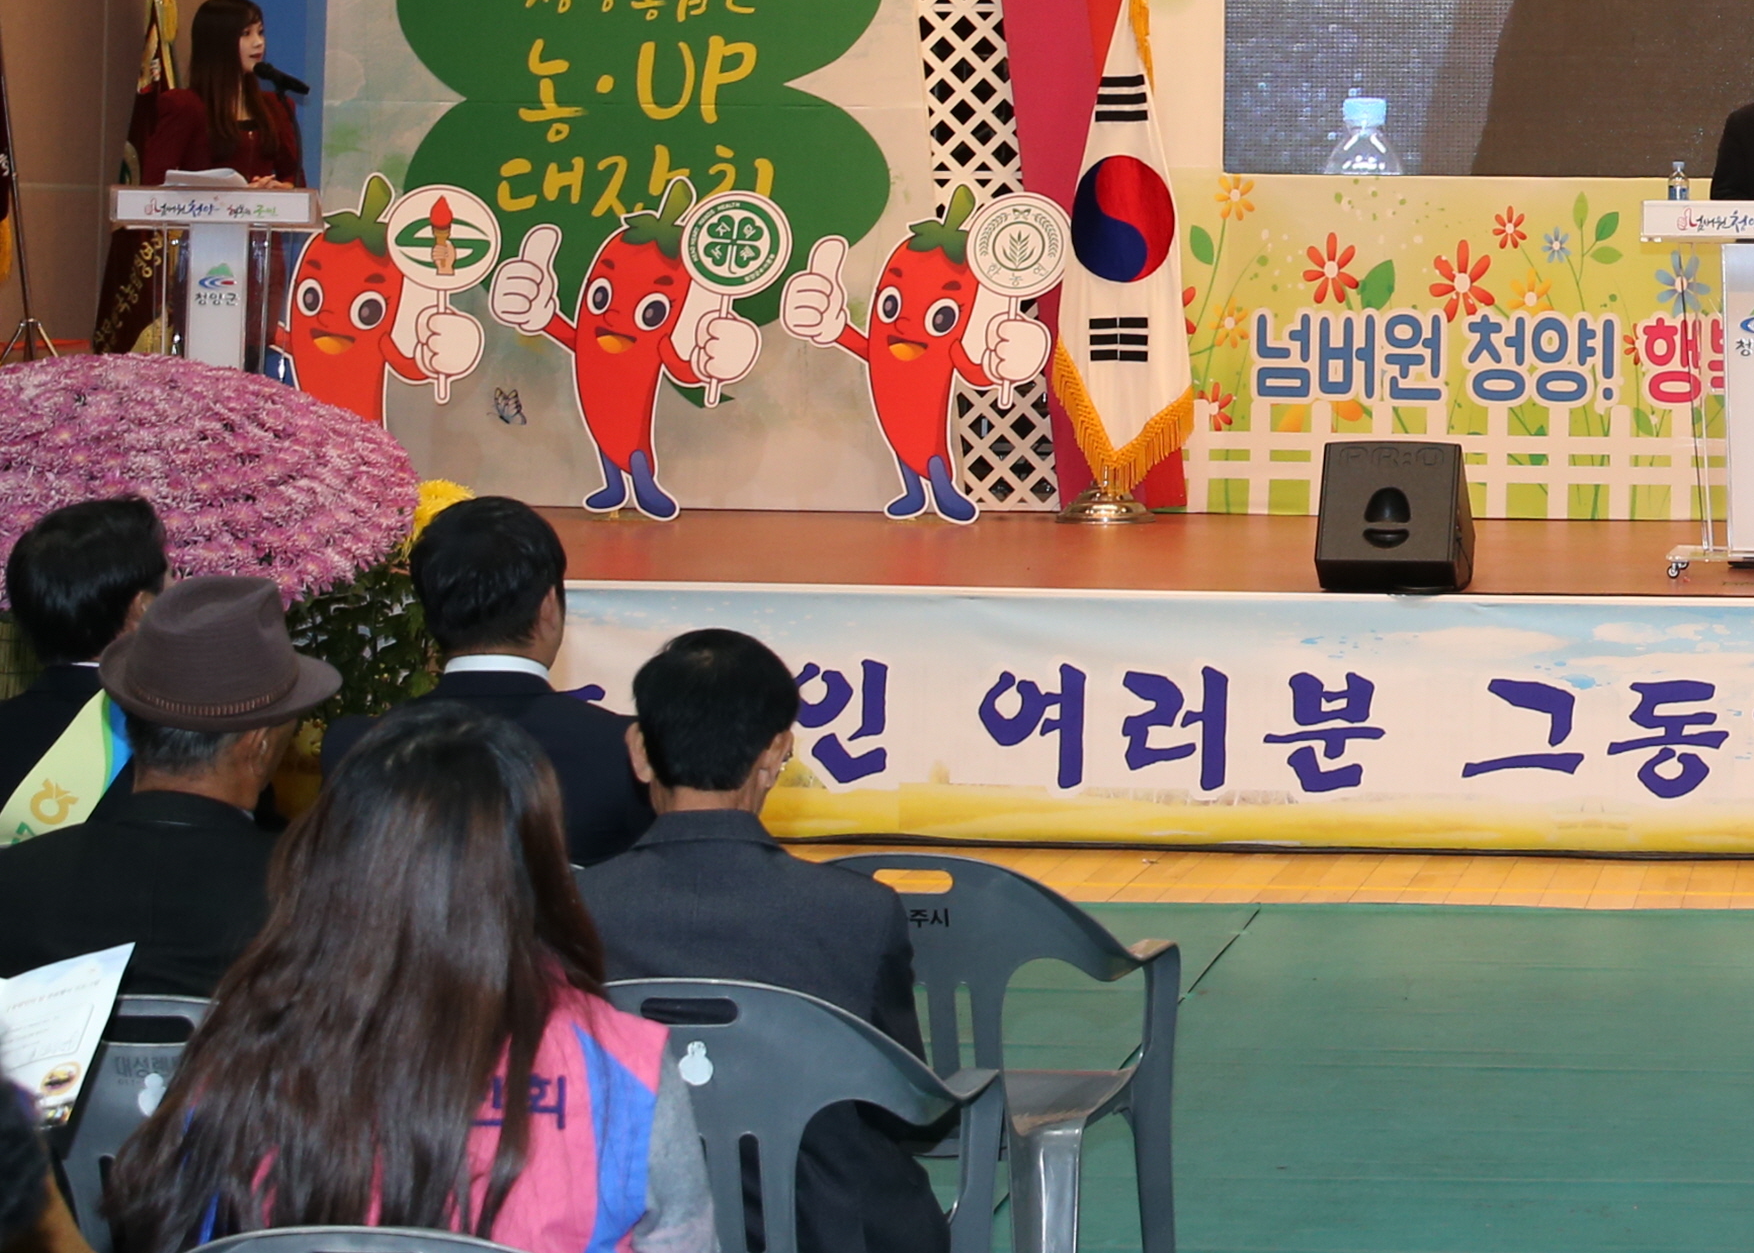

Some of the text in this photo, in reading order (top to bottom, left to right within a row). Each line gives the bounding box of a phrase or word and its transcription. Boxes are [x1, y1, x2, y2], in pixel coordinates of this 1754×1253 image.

[1255, 312, 1444, 401] 넘버원
[1466, 313, 1616, 403] 청양!
[978, 661, 1387, 794] 여러분
